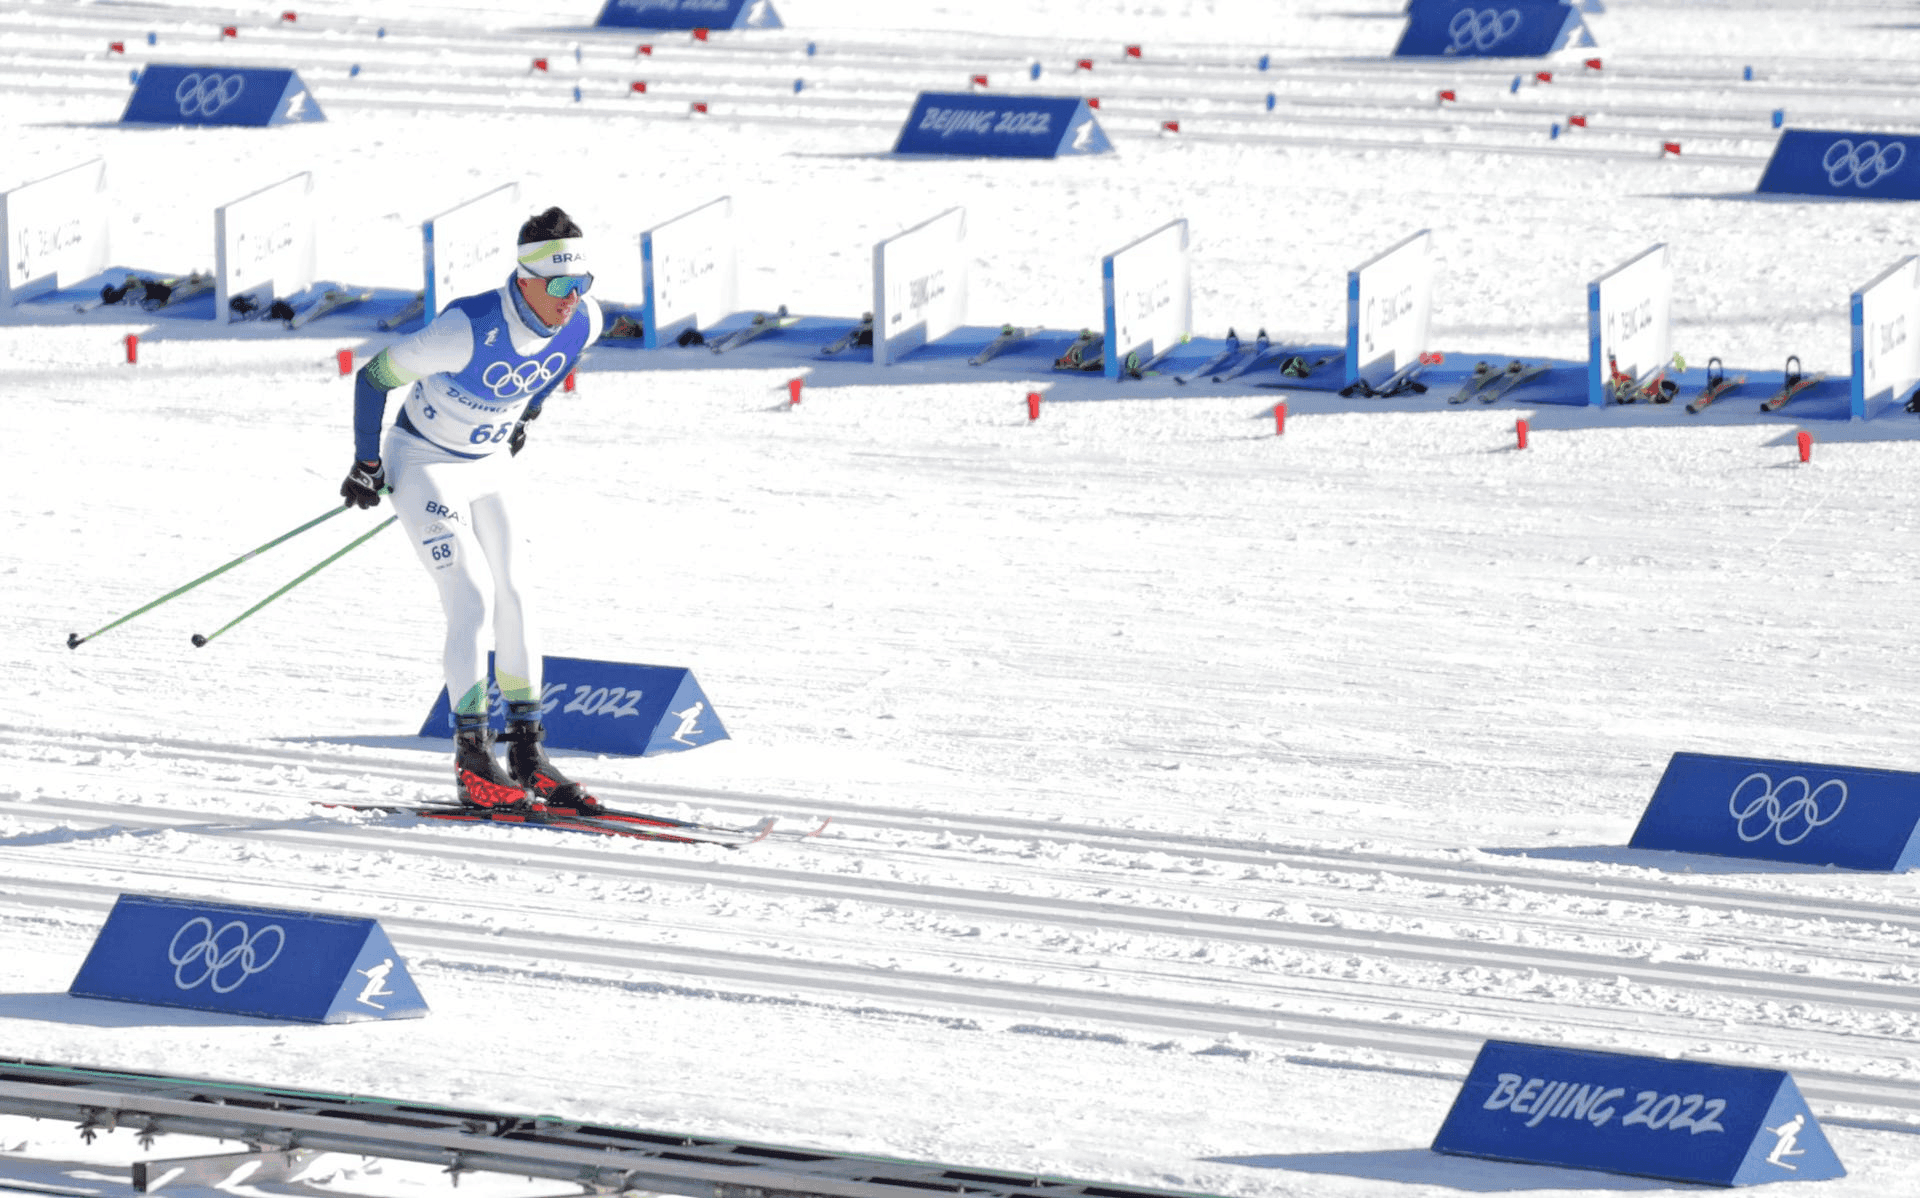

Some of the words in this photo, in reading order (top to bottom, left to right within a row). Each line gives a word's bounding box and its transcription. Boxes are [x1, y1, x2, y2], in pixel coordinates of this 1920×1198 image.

[918, 107, 996, 138] BEIJING
[993, 110, 1051, 135] 2022
[431, 543, 451, 561] 68
[563, 685, 643, 719] 2022
[1483, 1072, 1625, 1127] BEIJING
[1622, 1091, 1727, 1135] 2022
